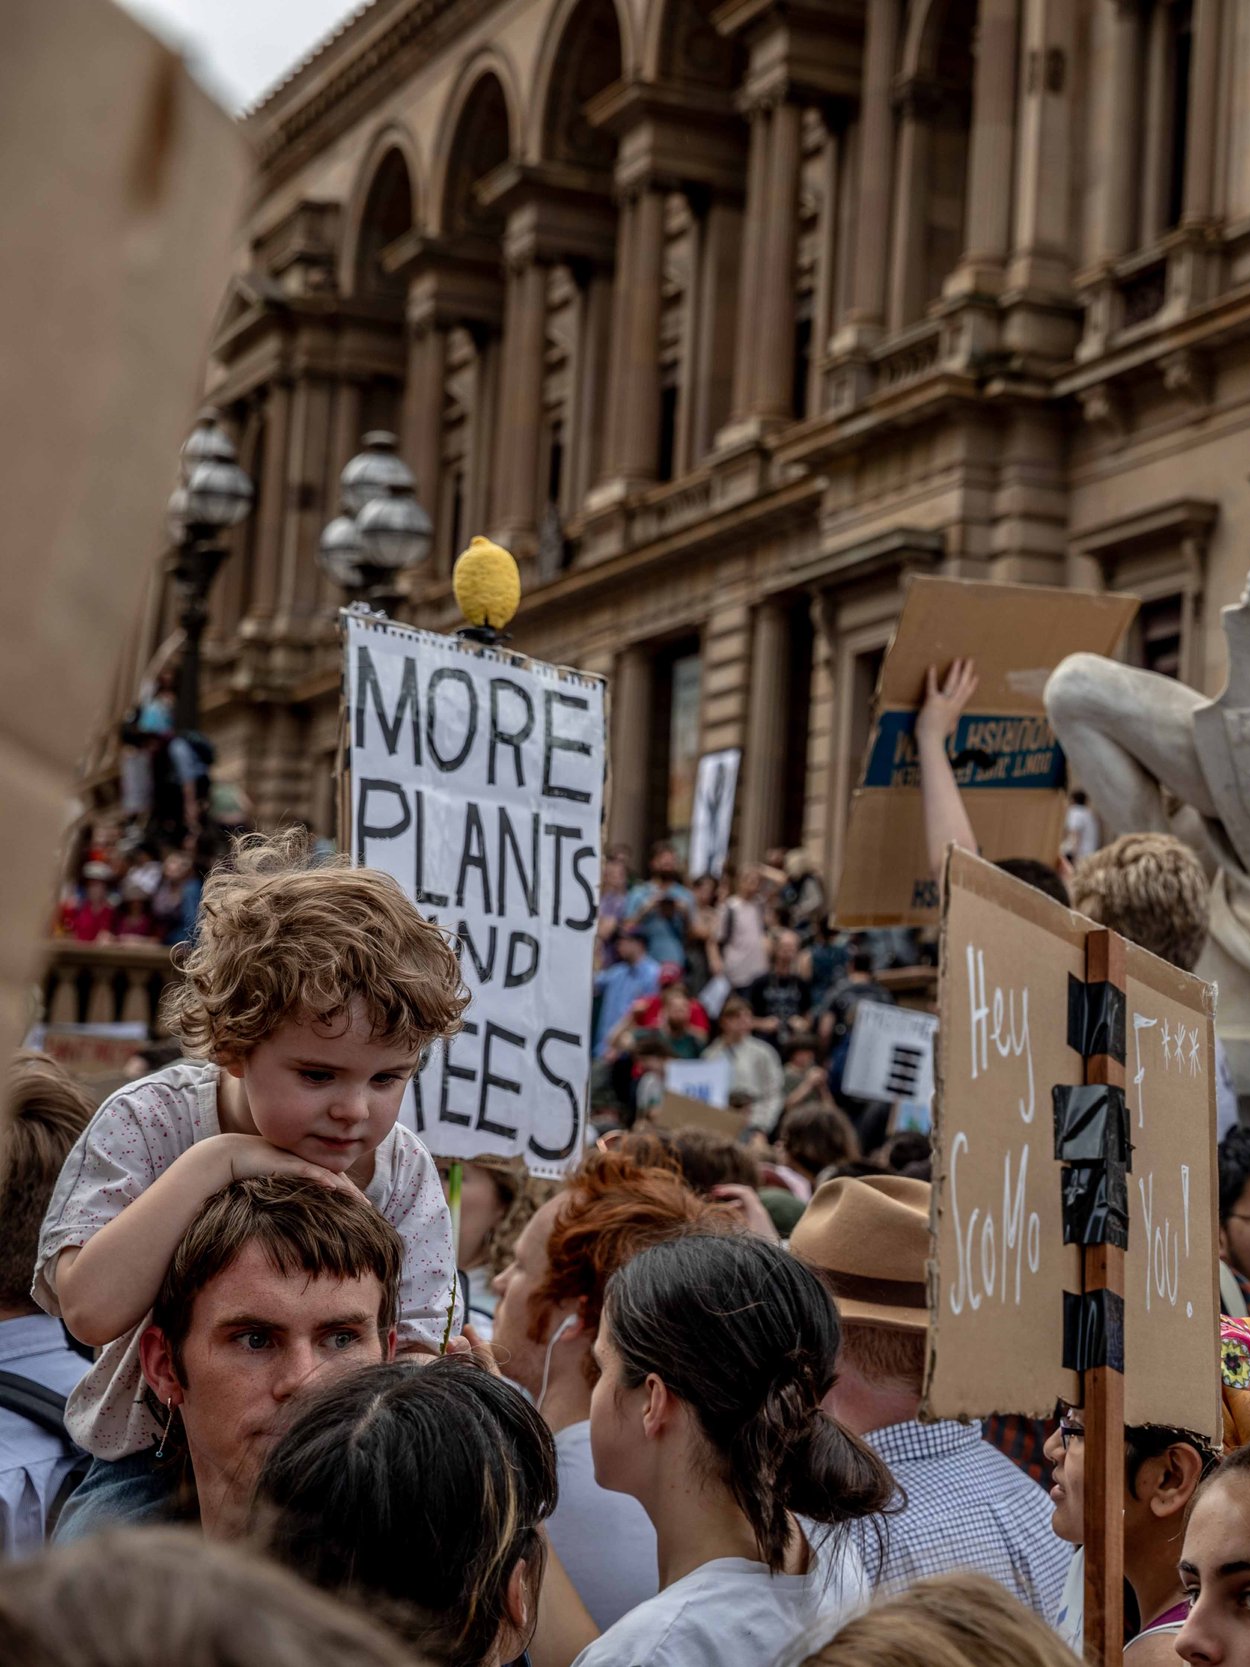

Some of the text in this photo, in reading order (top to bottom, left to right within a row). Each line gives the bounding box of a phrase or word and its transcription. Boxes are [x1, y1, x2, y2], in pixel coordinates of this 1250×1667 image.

[356, 646, 592, 803] MORE
[357, 778, 598, 932] PLANTS
[428, 914, 540, 988] ND
[966, 942, 1036, 1124] Hey
